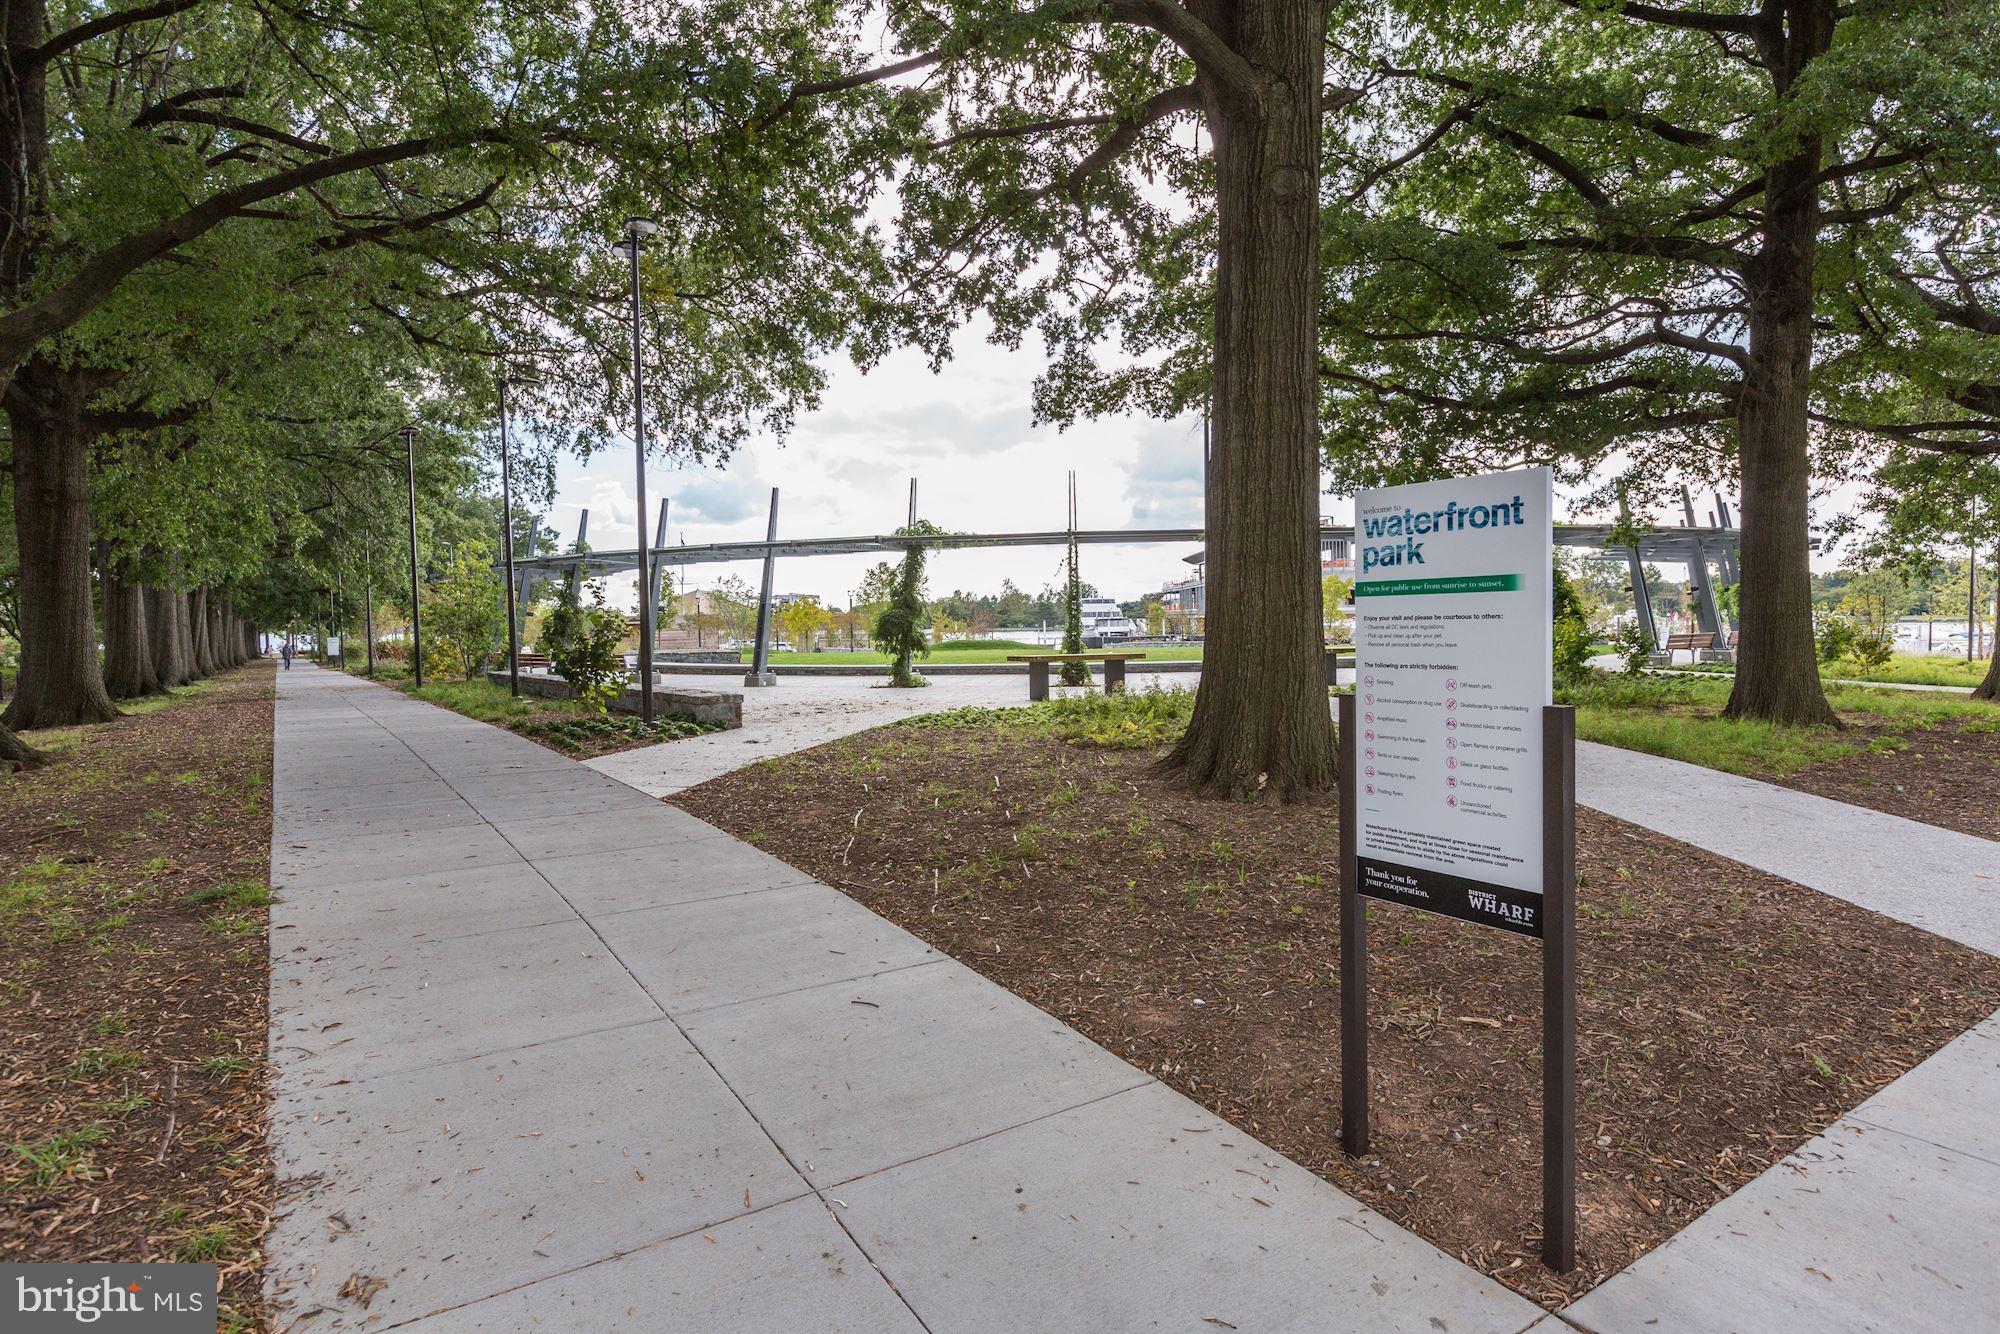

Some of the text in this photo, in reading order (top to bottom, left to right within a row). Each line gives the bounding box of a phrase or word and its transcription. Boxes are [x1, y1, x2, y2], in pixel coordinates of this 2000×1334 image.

[1363, 506, 1392, 514] welcome
[1363, 496, 1524, 538] waterfront
[1363, 537, 1425, 574] park
[1364, 585, 1380, 594] Open
[1391, 584, 1409, 592] public
[1442, 580, 1468, 589] sunrise
[1478, 580, 1504, 588] sunset.
[1460, 702, 1492, 710] Skateboarding
[1500, 704, 1529, 713] rollerblading
[1460, 740, 1473, 748] Open
[1496, 744, 1516, 752] propane
[1516, 746, 1528, 754] grills
[1460, 780, 1472, 788] Food
[1472, 782, 1487, 790] trucks
[1494, 784, 1512, 794] catering
[1460, 800, 1492, 810] Unsanctioned
[1460, 808, 1486, 816] commercial
[1366, 824, 1388, 832] Waterfront
[1407, 830, 1426, 839] privately
[1426, 834, 1451, 842] maintained
[1482, 844, 1500, 852] created
[1382, 846, 1404, 854] immediate
[1469, 848, 1490, 858] seasonal
[1492, 852, 1524, 863] maintenance
[1466, 854, 1494, 865] regulations
[1366, 866, 1418, 886] Thank you for
[1366, 878, 1430, 898] your cooperation.
[1468, 888, 1497, 900] DISTRICT
[1468, 894, 1534, 922] WHARF
